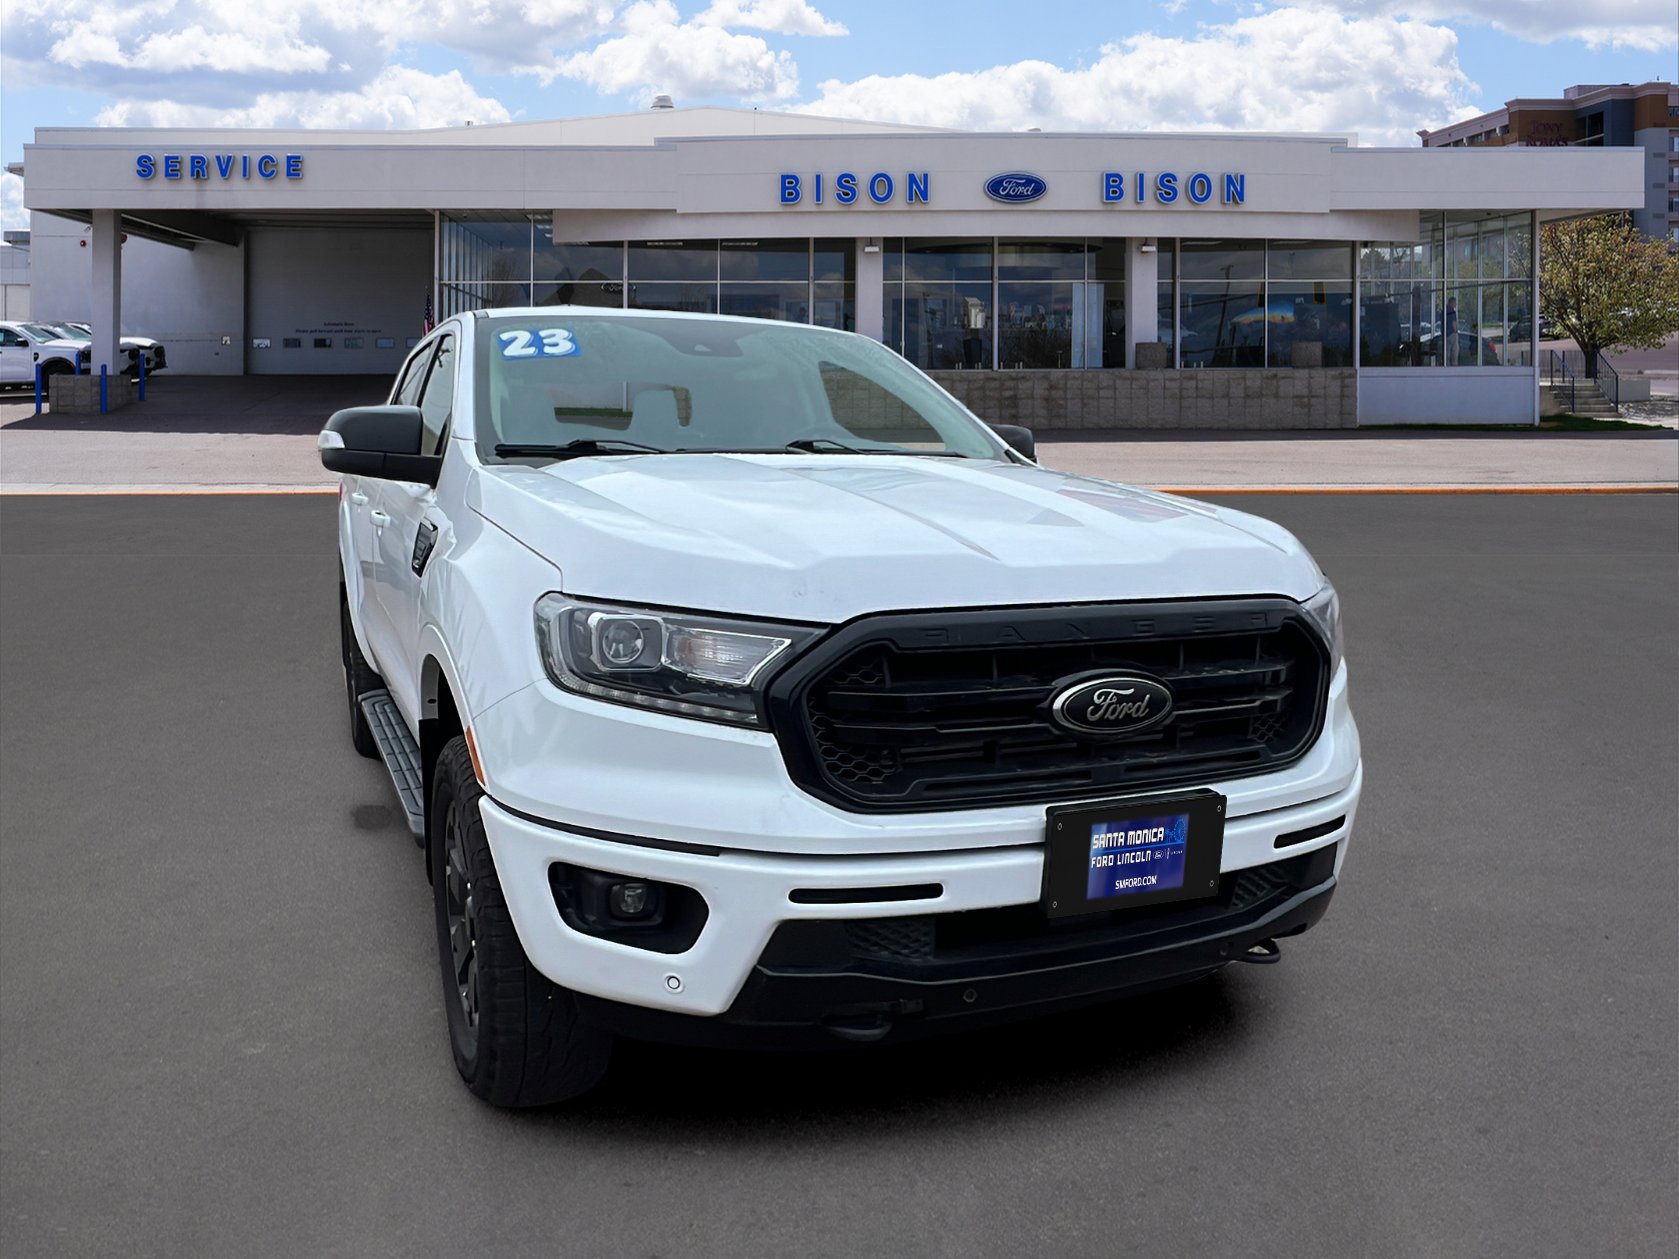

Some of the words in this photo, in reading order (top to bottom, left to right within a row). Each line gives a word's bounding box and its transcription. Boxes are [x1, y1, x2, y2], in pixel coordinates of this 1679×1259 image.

[135, 153, 304, 180] SERVICE
[779, 171, 931, 205] BISON
[999, 178, 1035, 195] Ford
[1102, 171, 1247, 205] BISON
[499, 328, 576, 358] 23
[1086, 688, 1151, 722] Ford
[1092, 831, 1125, 849] SANTA
[1127, 827, 1165, 846] MONICA
[1091, 854, 1114, 868] FORD
[1117, 850, 1152, 865] LINCOLN
[1115, 875, 1158, 890] SMFORD.COM
